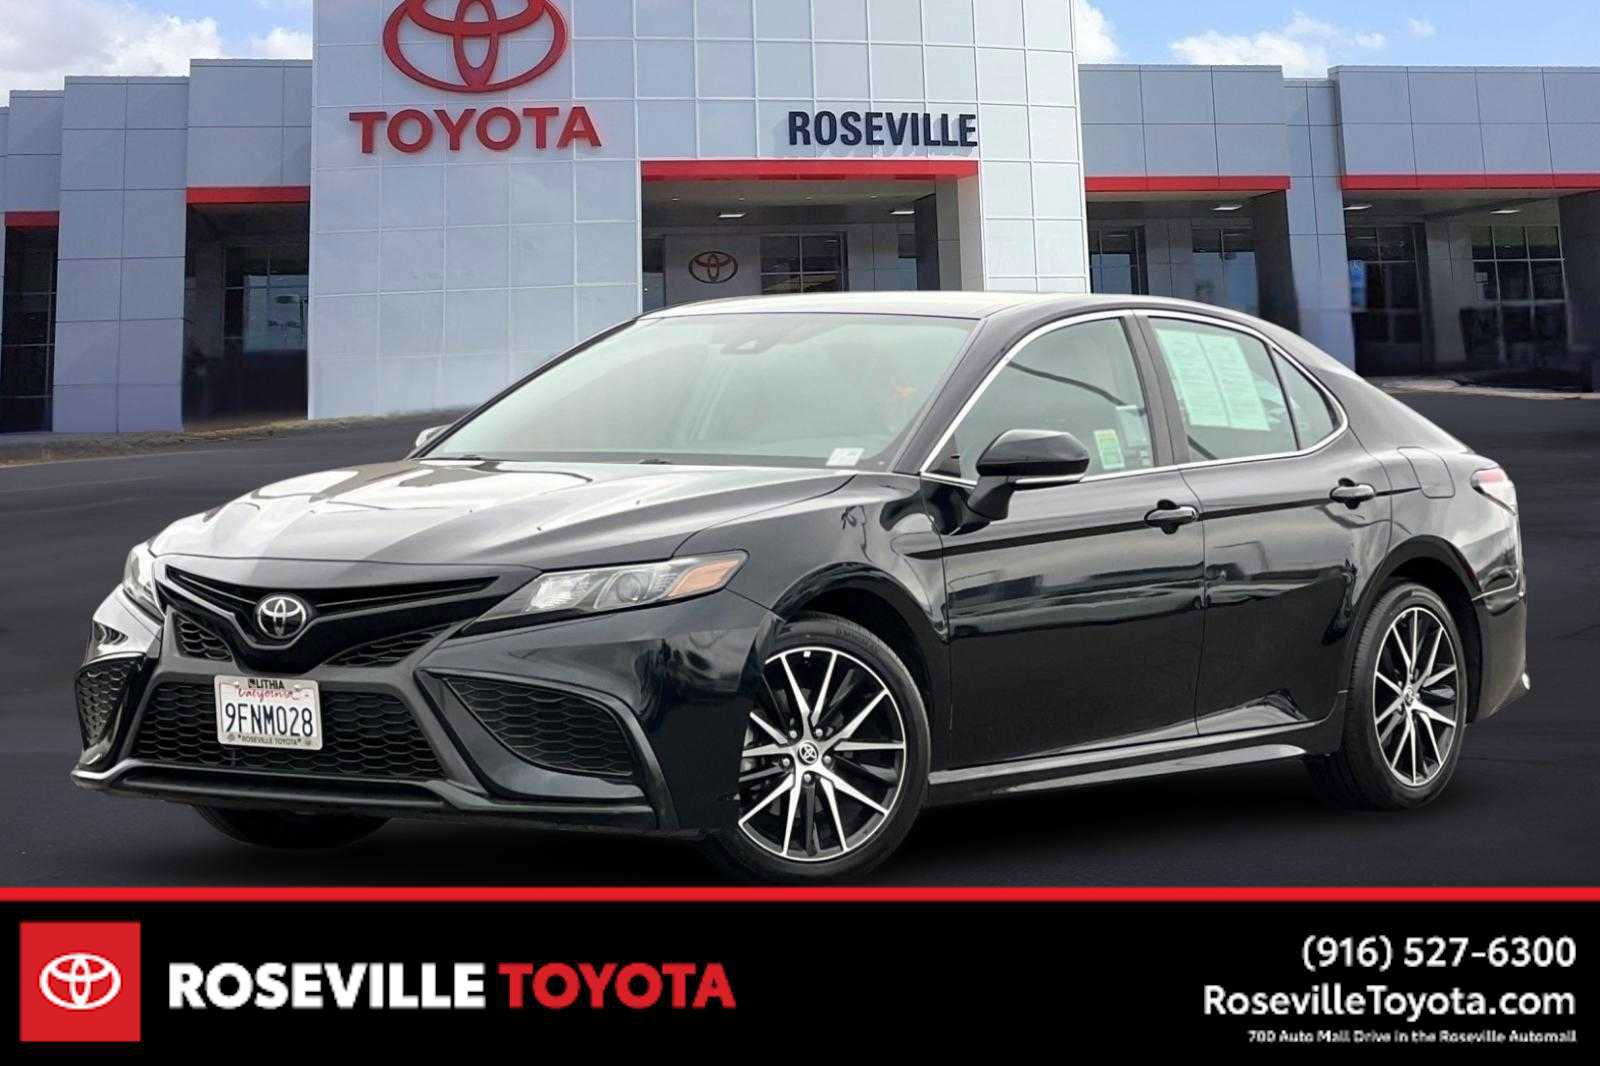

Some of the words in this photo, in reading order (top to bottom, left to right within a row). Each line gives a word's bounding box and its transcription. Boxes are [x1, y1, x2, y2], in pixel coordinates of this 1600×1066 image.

[349, 106, 602, 153] TOYOTA
[788, 111, 979, 147] ROSEVILLE
[256, 679, 286, 690] LITHIA
[225, 702, 313, 737] 9FNM028
